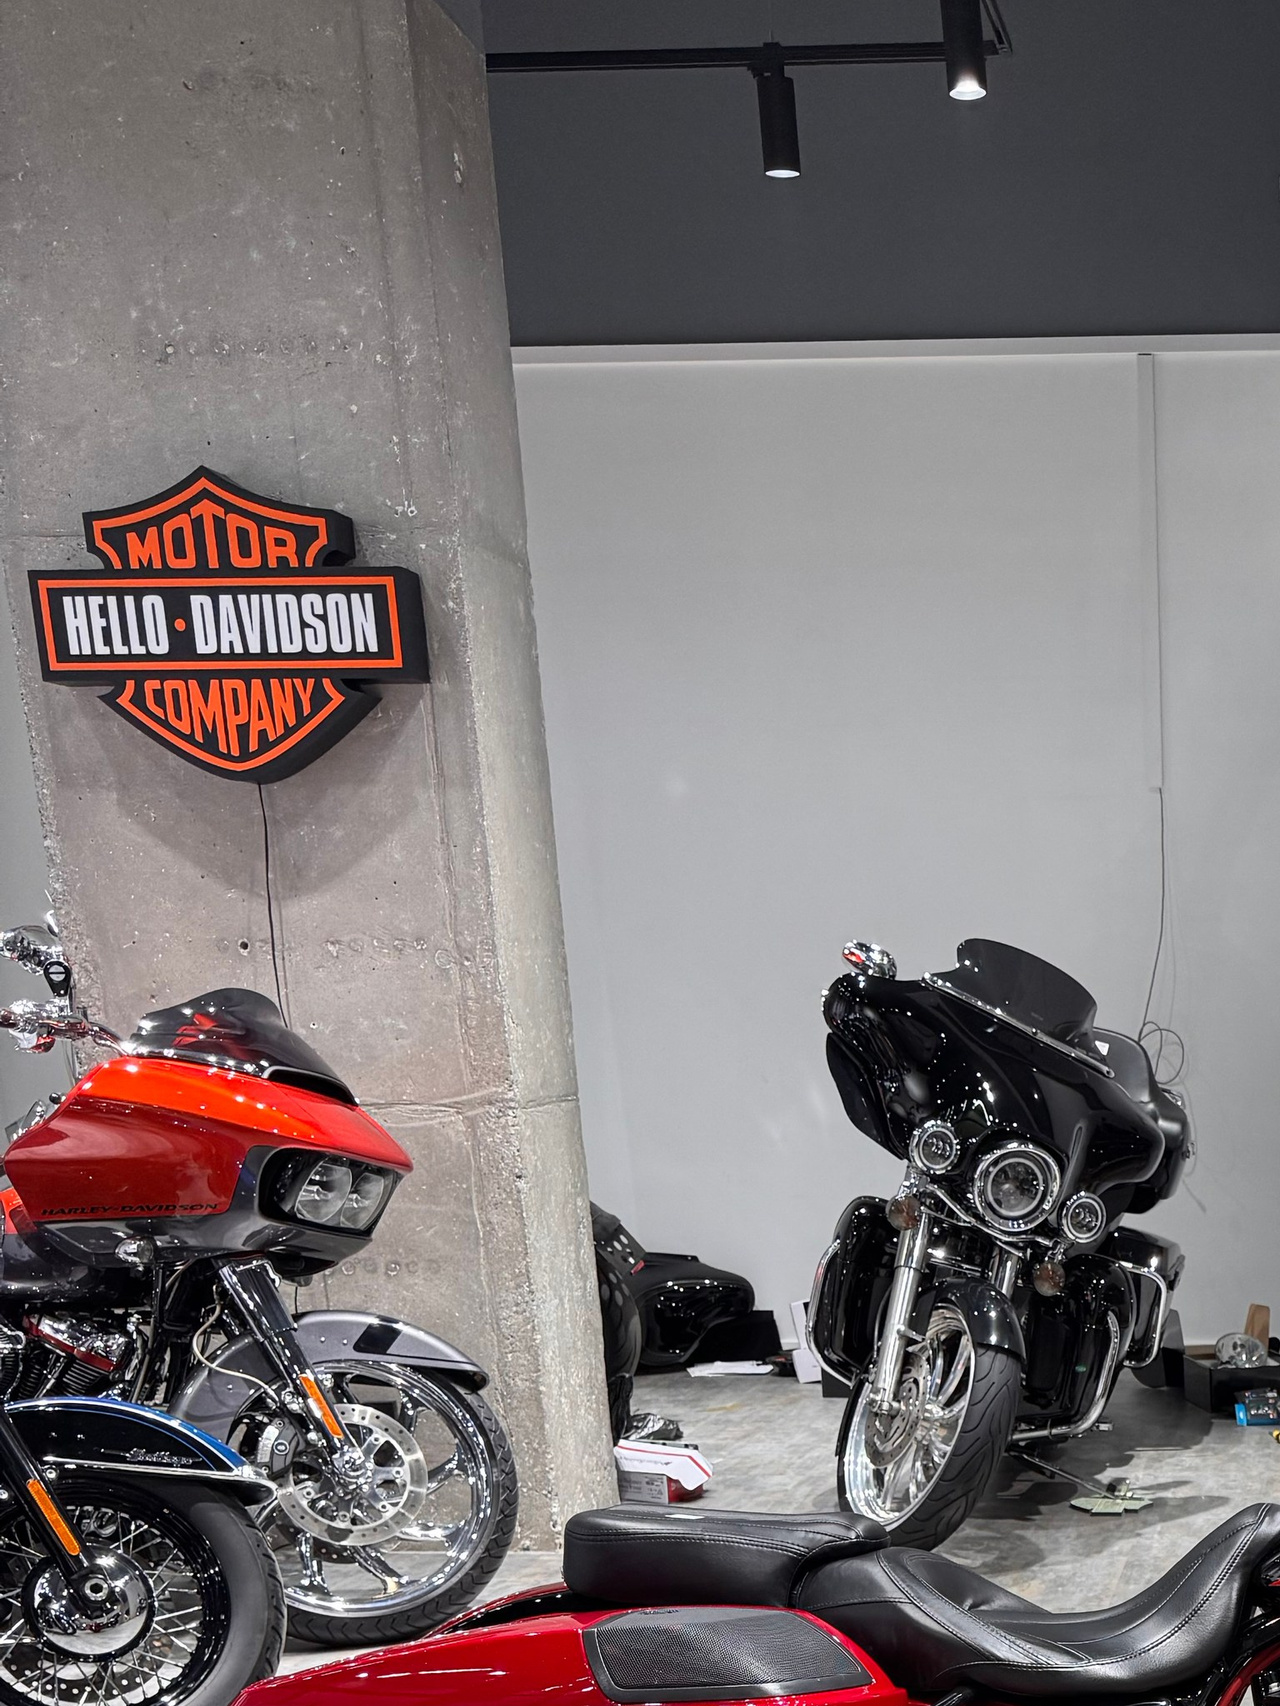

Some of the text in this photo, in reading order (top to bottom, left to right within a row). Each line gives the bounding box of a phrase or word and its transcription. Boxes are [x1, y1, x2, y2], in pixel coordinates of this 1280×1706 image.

[126, 499, 298, 569] MOTOR
[62, 593, 379, 656] HELLO DAVIDSON
[144, 677, 315, 757] COMPANY
[41, 1203, 219, 1216] HARLEY-DAVIDSON
